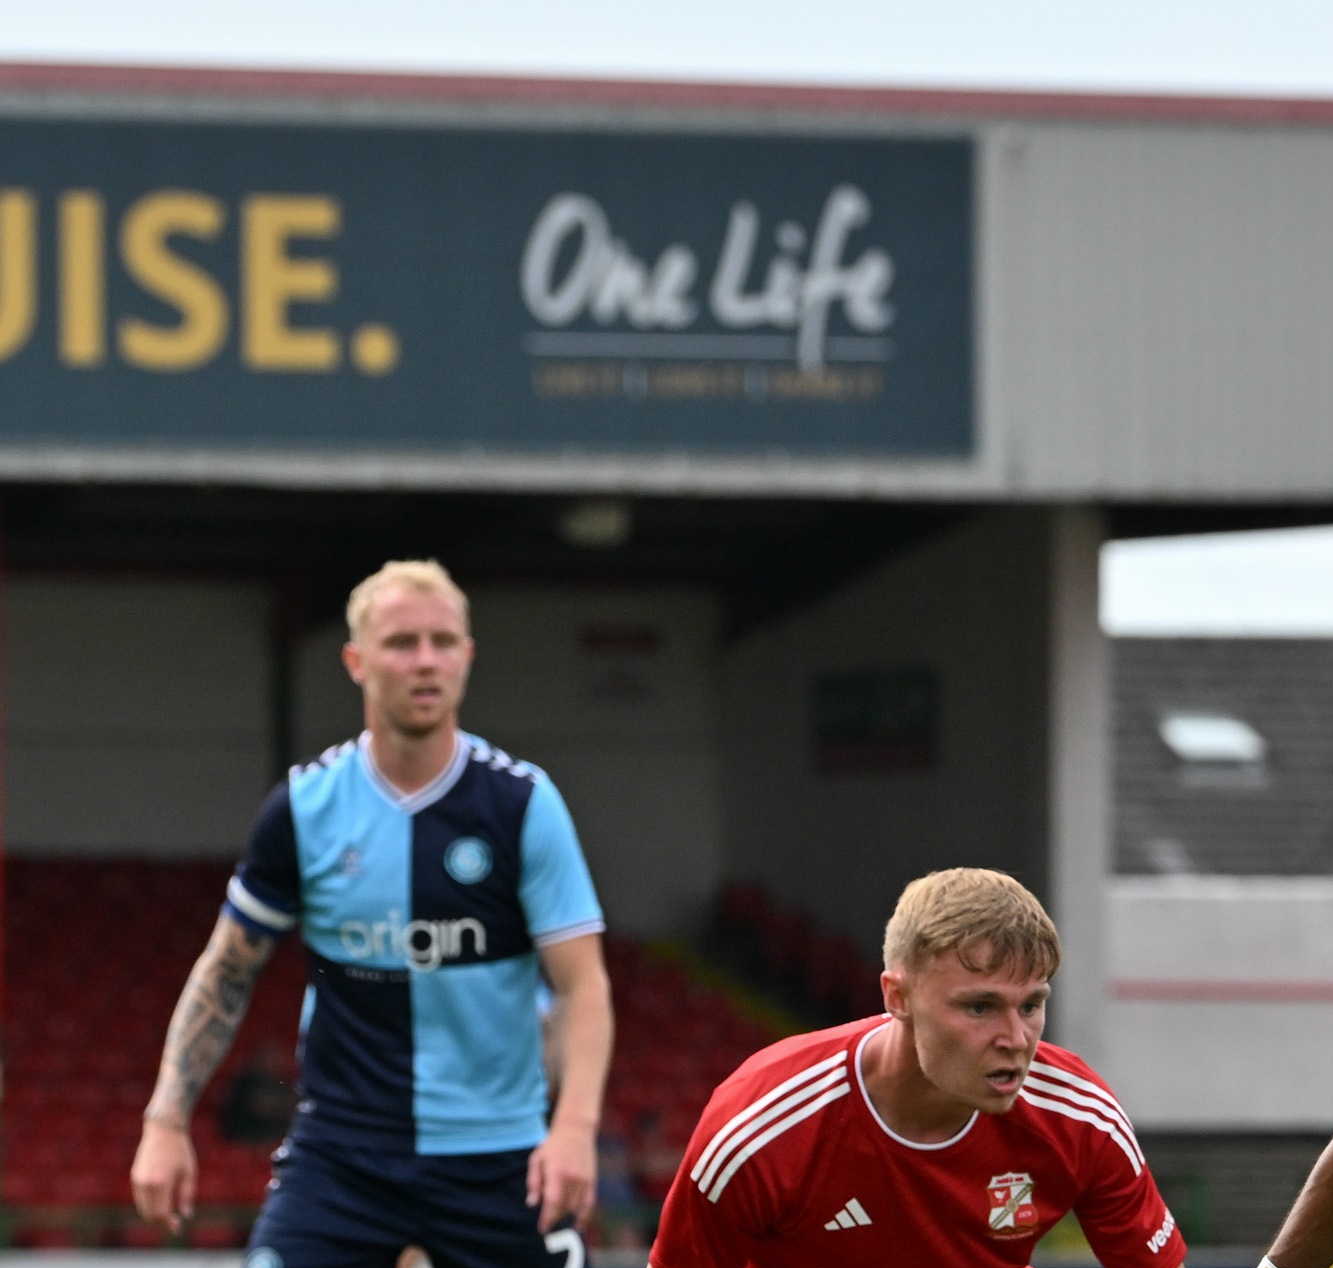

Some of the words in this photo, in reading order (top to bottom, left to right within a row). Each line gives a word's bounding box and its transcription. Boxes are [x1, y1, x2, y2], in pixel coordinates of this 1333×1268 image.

[520, 191, 699, 331] One
[710, 184, 895, 371] Life
[340, 908, 487, 973] origin
